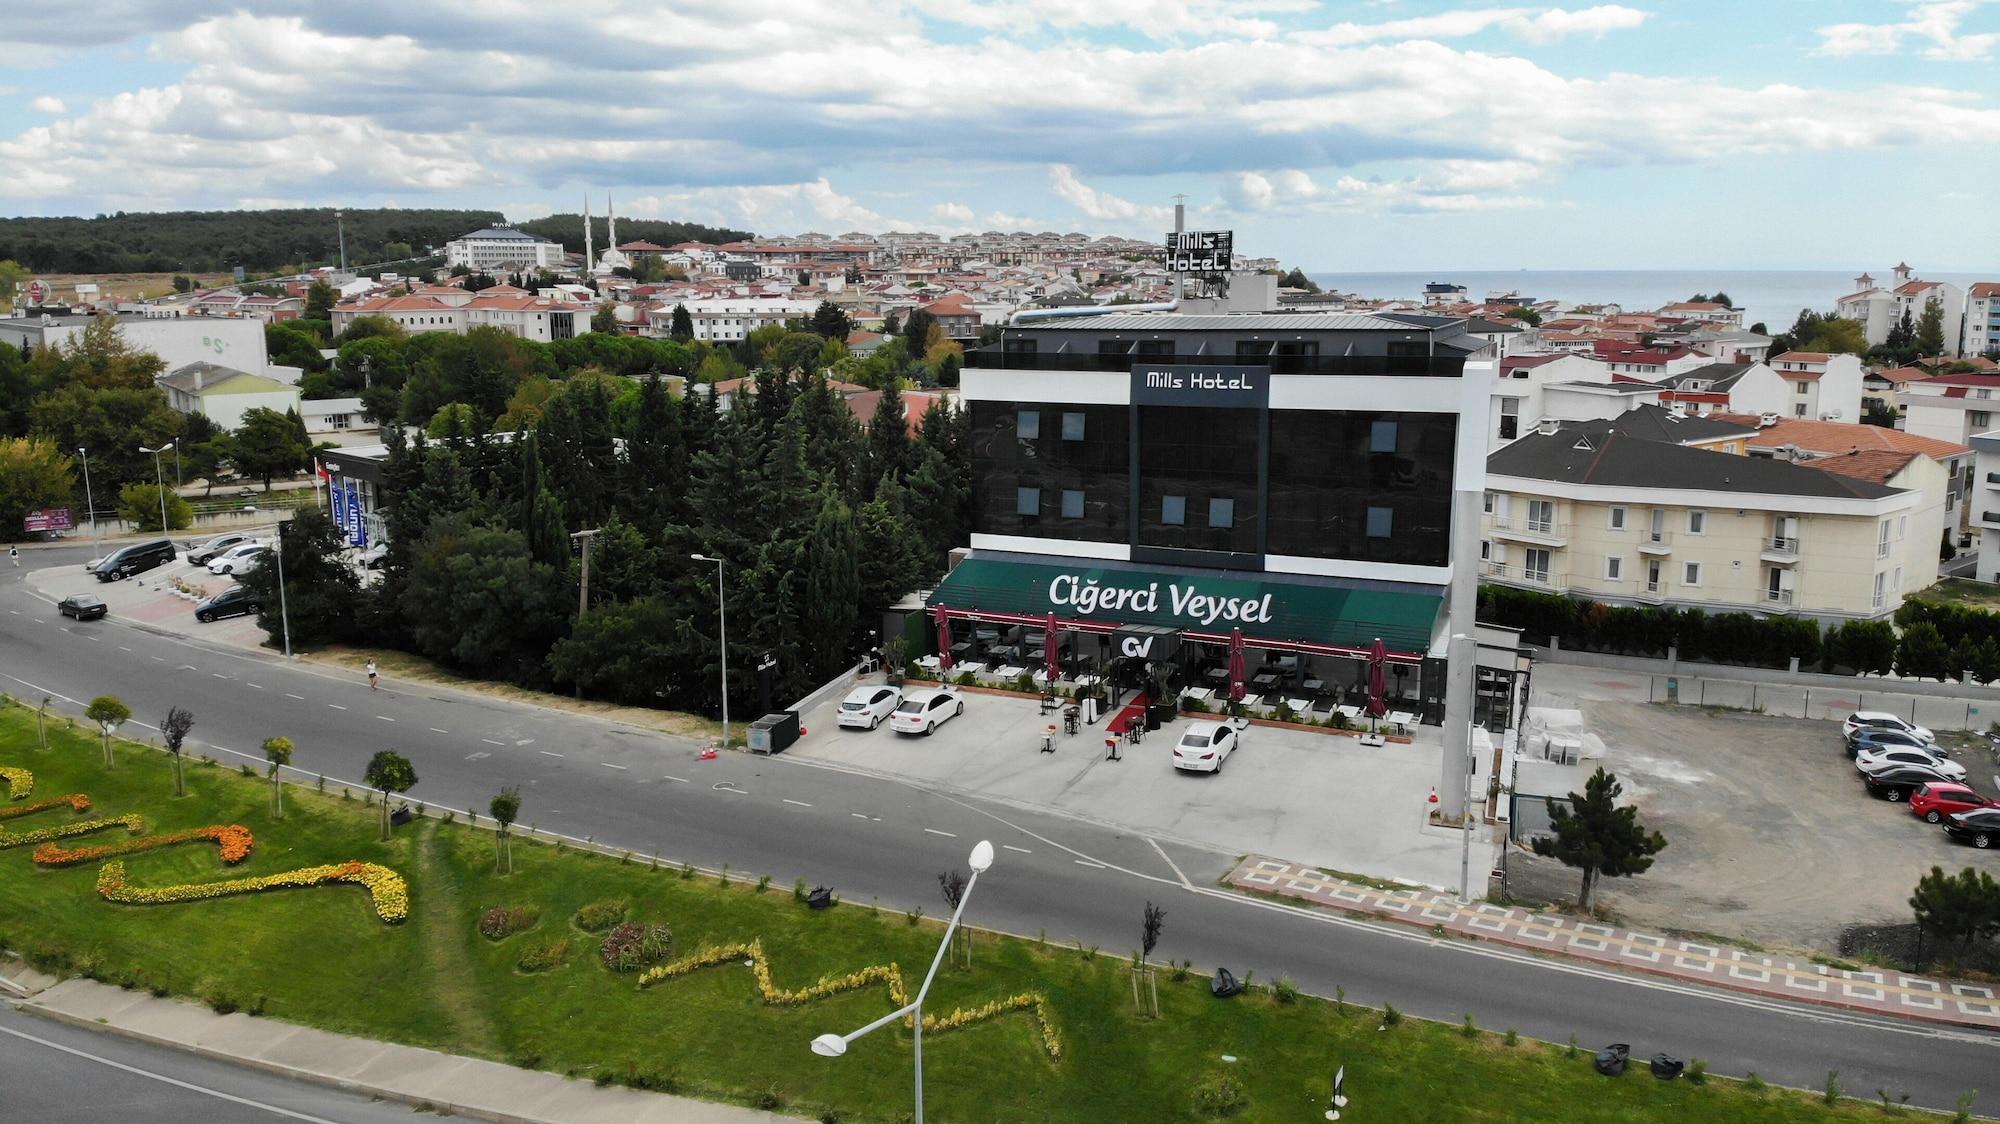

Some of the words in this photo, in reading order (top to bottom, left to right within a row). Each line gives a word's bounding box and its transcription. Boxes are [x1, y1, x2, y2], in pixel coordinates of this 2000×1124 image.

[1177, 231, 1215, 249] Mills
[1146, 372, 1183, 388] Mills
[1049, 574, 1158, 614] Ciğerci
[1169, 584, 1273, 626] Veysel
[1121, 636, 1154, 658] CV
